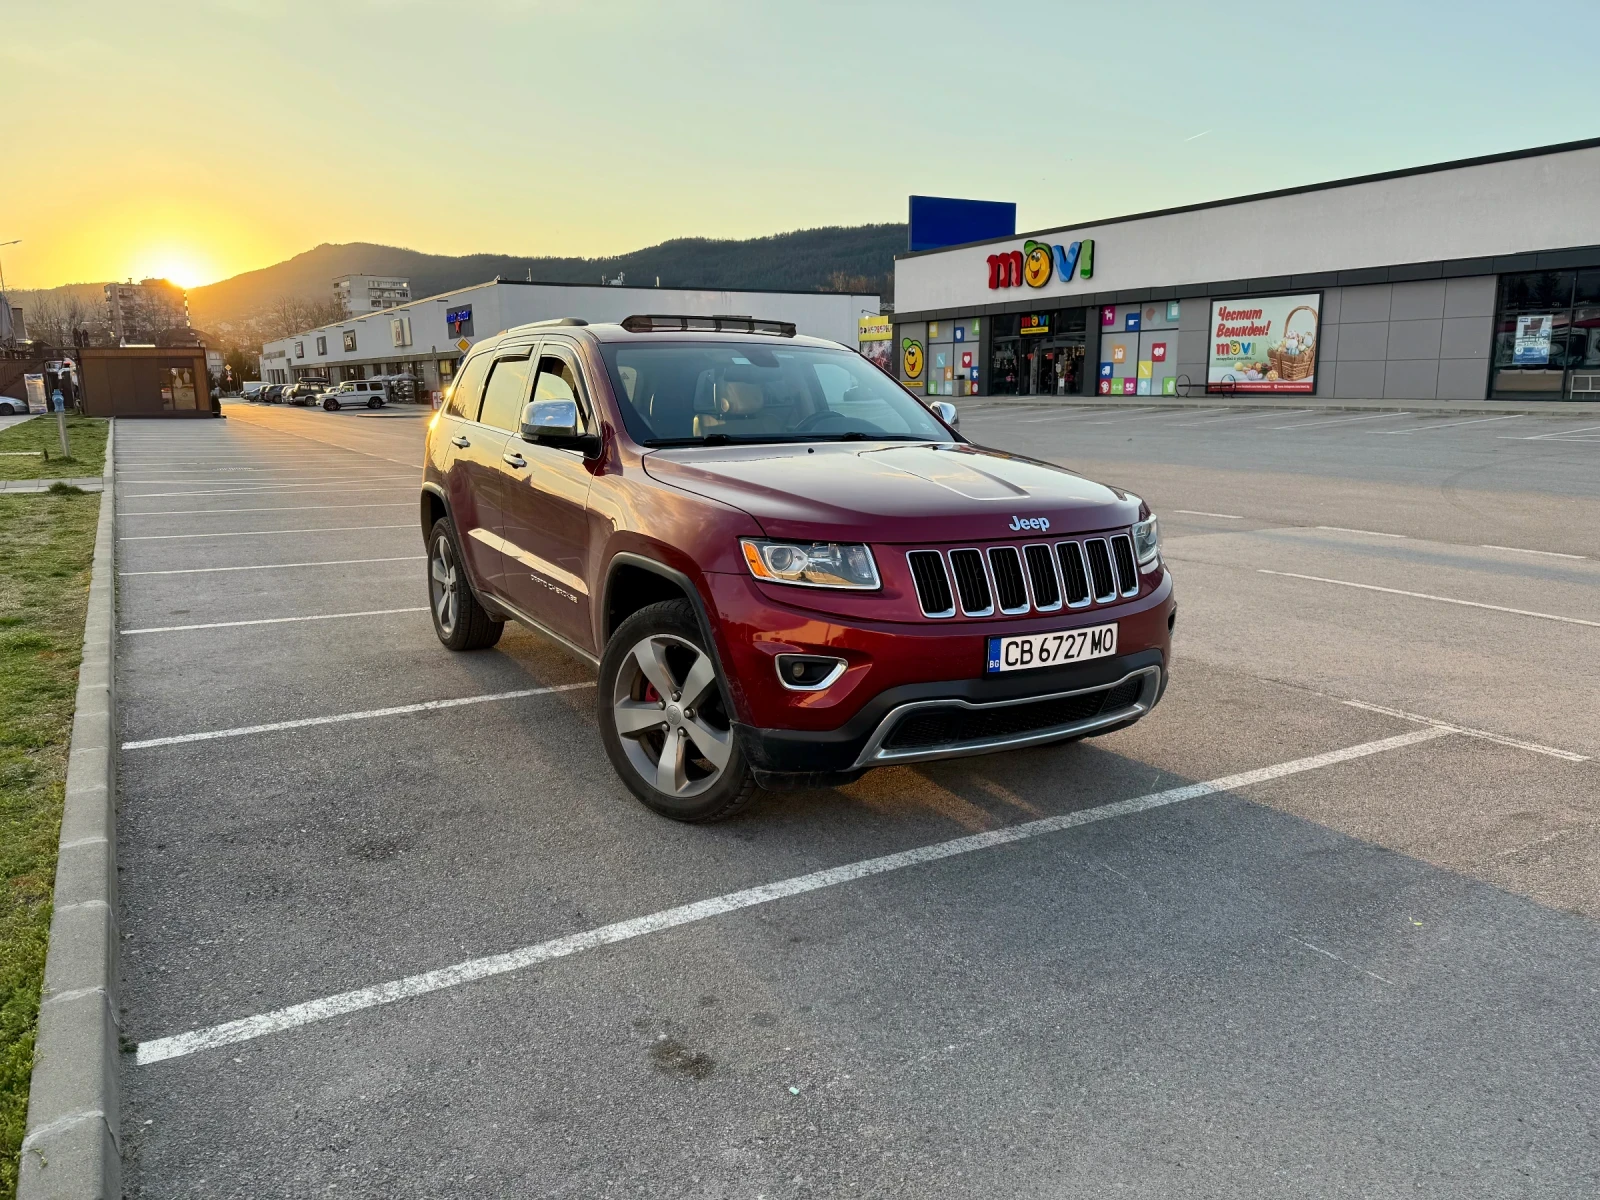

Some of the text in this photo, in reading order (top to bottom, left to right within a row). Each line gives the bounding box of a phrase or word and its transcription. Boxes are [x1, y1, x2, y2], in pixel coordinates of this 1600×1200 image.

[1218, 306, 1262, 321] Честит
[1216, 320, 1271, 338] Великден!
[1008, 515, 1051, 532] Jeep
[1004, 628, 1114, 667] CB 6727 MO
[989, 659, 1000, 668] BG
